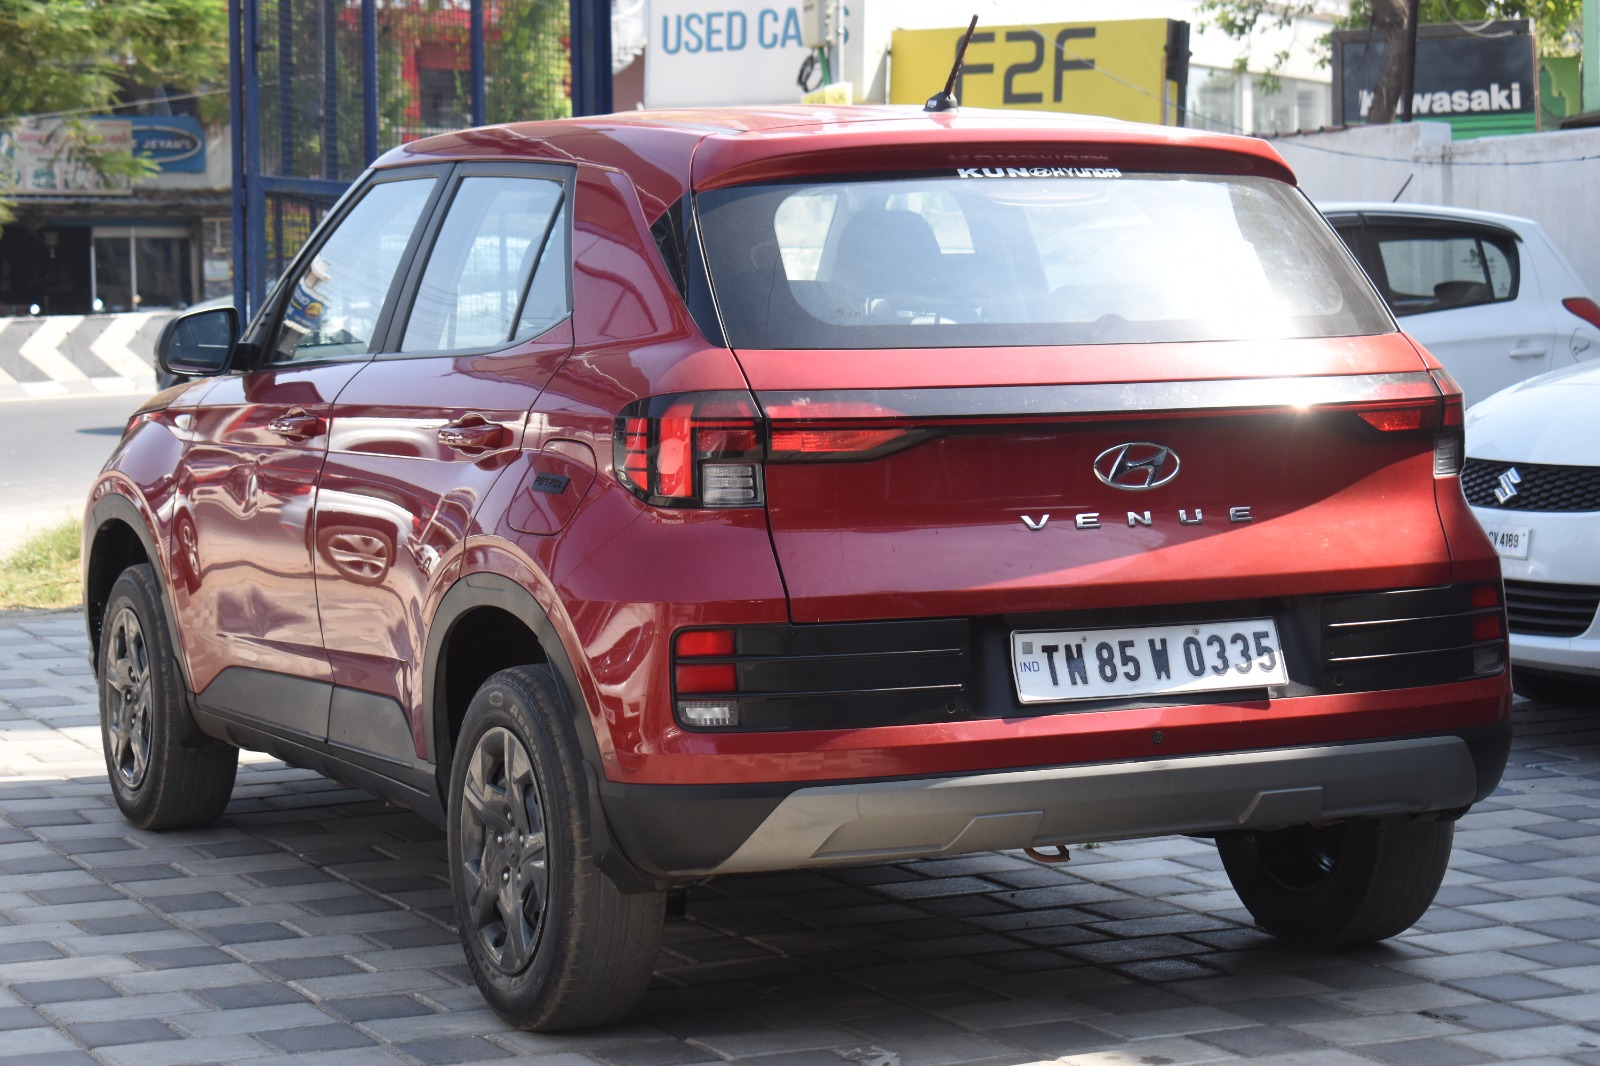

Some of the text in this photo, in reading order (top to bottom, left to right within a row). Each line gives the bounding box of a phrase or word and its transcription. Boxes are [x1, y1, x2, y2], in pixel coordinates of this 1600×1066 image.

[662, 11, 747, 55] USED
[955, 27, 1096, 106] F2F
[957, 168, 1122, 178] KUN HYUNDAI
[1020, 506, 1253, 531] VENUE
[1499, 532, 1519, 548] 4189
[1019, 661, 1040, 673] IND
[1041, 631, 1277, 686] TN 85 W 0335
